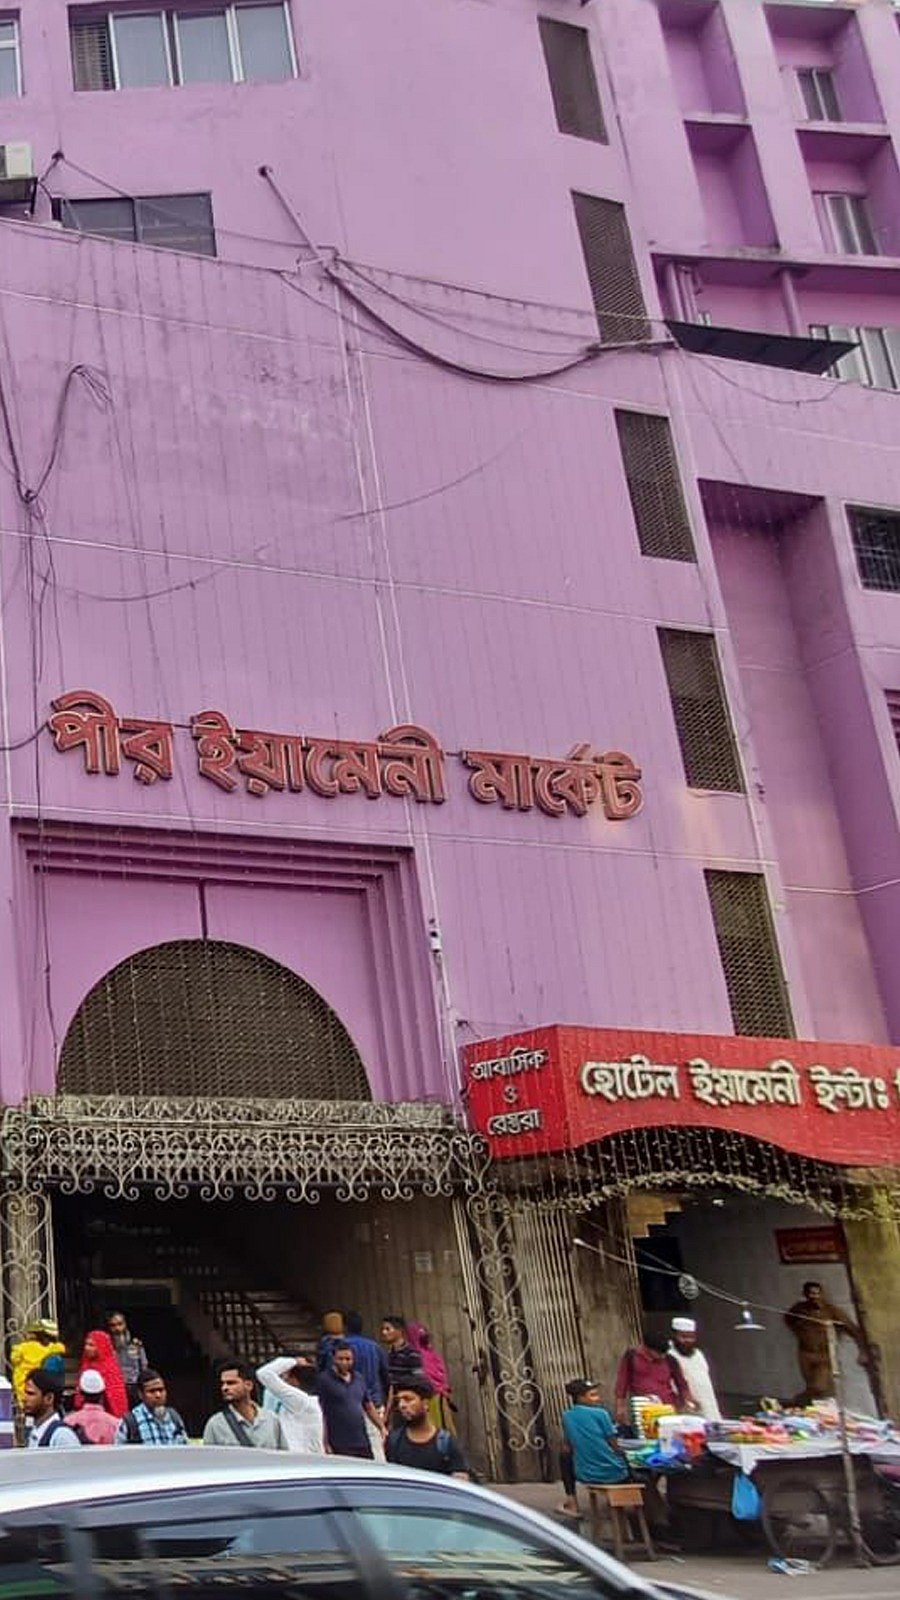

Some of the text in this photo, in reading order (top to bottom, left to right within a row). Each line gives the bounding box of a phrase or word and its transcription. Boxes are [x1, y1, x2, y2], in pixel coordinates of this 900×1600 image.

[49, 690, 644, 820] পীর ইয়ামেনী মার্কেট
[470, 1047, 549, 1080] আবাসিক
[580, 1054, 681, 1103] হোটেল
[688, 1057, 802, 1107] ইয়ামেনী
[503, 1085, 518, 1104] ও
